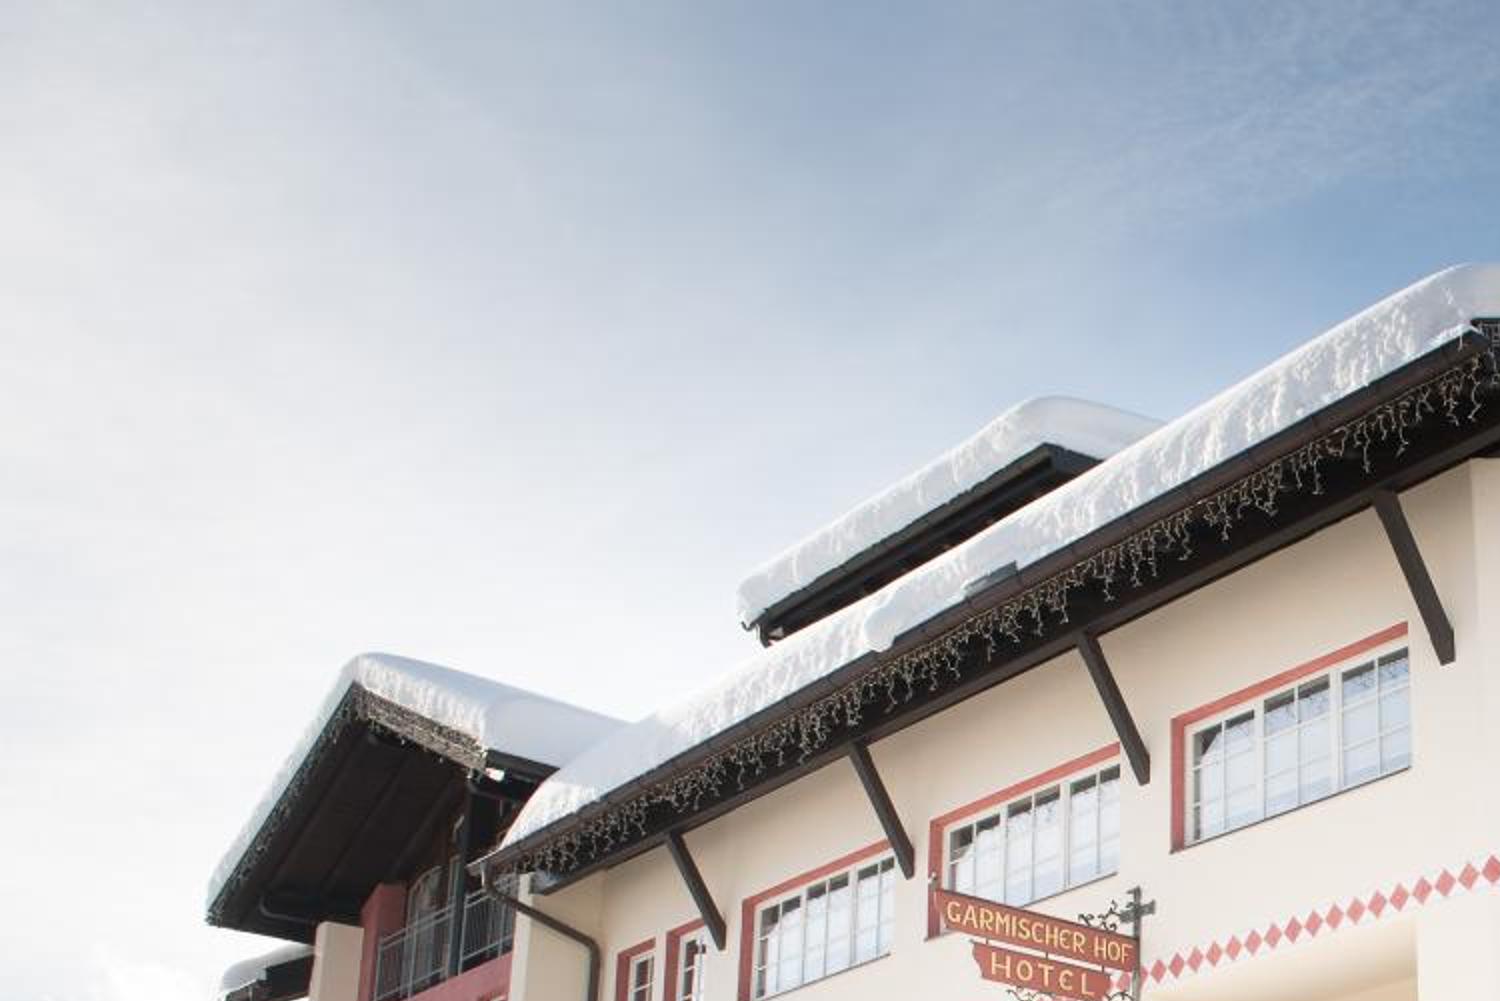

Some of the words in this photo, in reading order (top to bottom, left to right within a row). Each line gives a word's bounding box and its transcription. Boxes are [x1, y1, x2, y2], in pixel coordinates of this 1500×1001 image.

[946, 901, 1086, 953] GARMISCHER
[1093, 938, 1133, 964] HOF
[990, 951, 1096, 996] HOTEL
